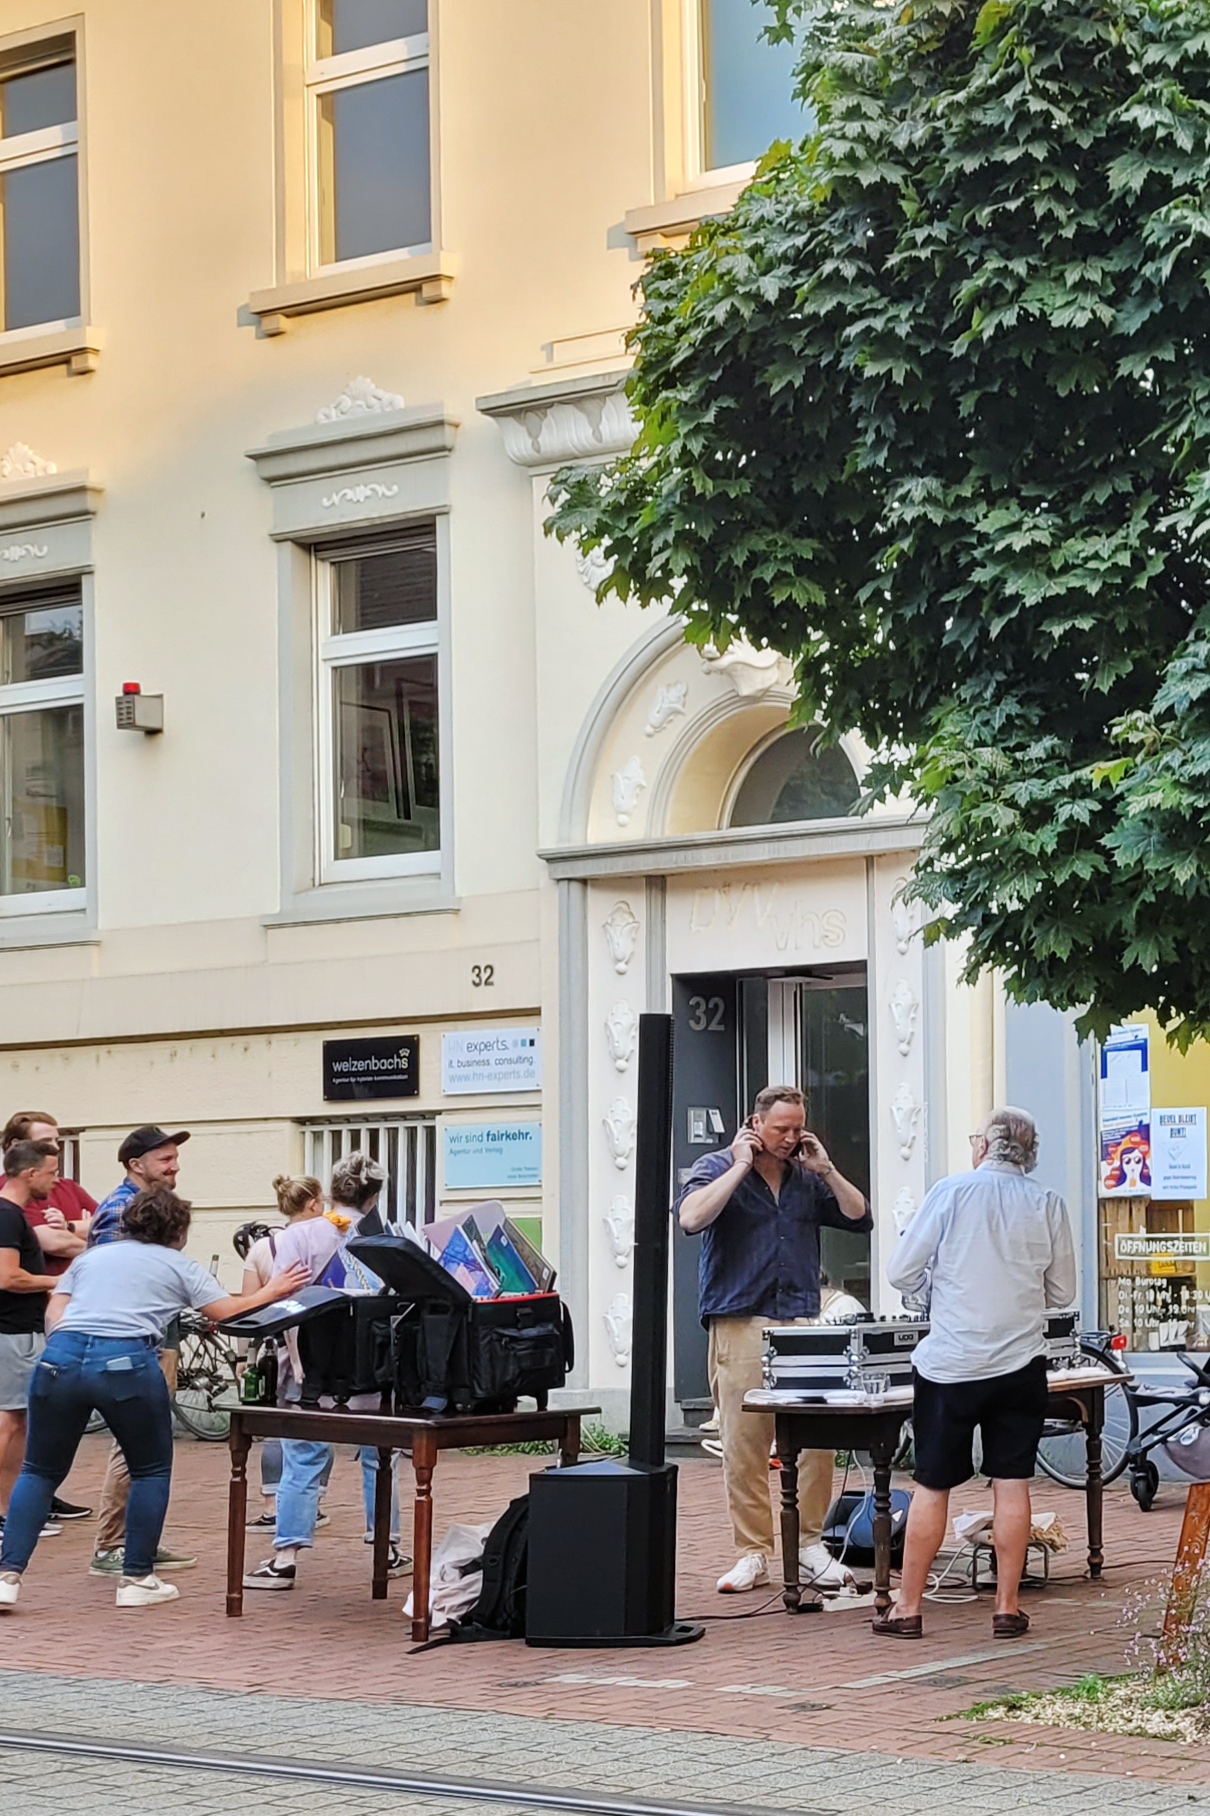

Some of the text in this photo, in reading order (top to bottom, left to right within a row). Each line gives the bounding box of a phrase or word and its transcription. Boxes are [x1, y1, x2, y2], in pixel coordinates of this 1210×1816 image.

[769, 901, 847, 951] vhs
[471, 964, 495, 987] 32
[688, 995, 725, 1032] 32
[466, 1037, 509, 1055] experts.
[332, 1053, 409, 1072] welzenbachs
[449, 1068, 536, 1083] www.hn-experts.de
[449, 1129, 532, 1144] wir sind fairkehr.
[1120, 1239, 1207, 1254] ÖFFNUNGSZEITEN
[1135, 1276, 1167, 1288] Bürotag
[1134, 1304, 1144, 1314] 10
[1145, 1304, 1160, 1314] Uhr
[1134, 1318, 1143, 1328] 10
[1145, 1318, 1160, 1328] Uhr
